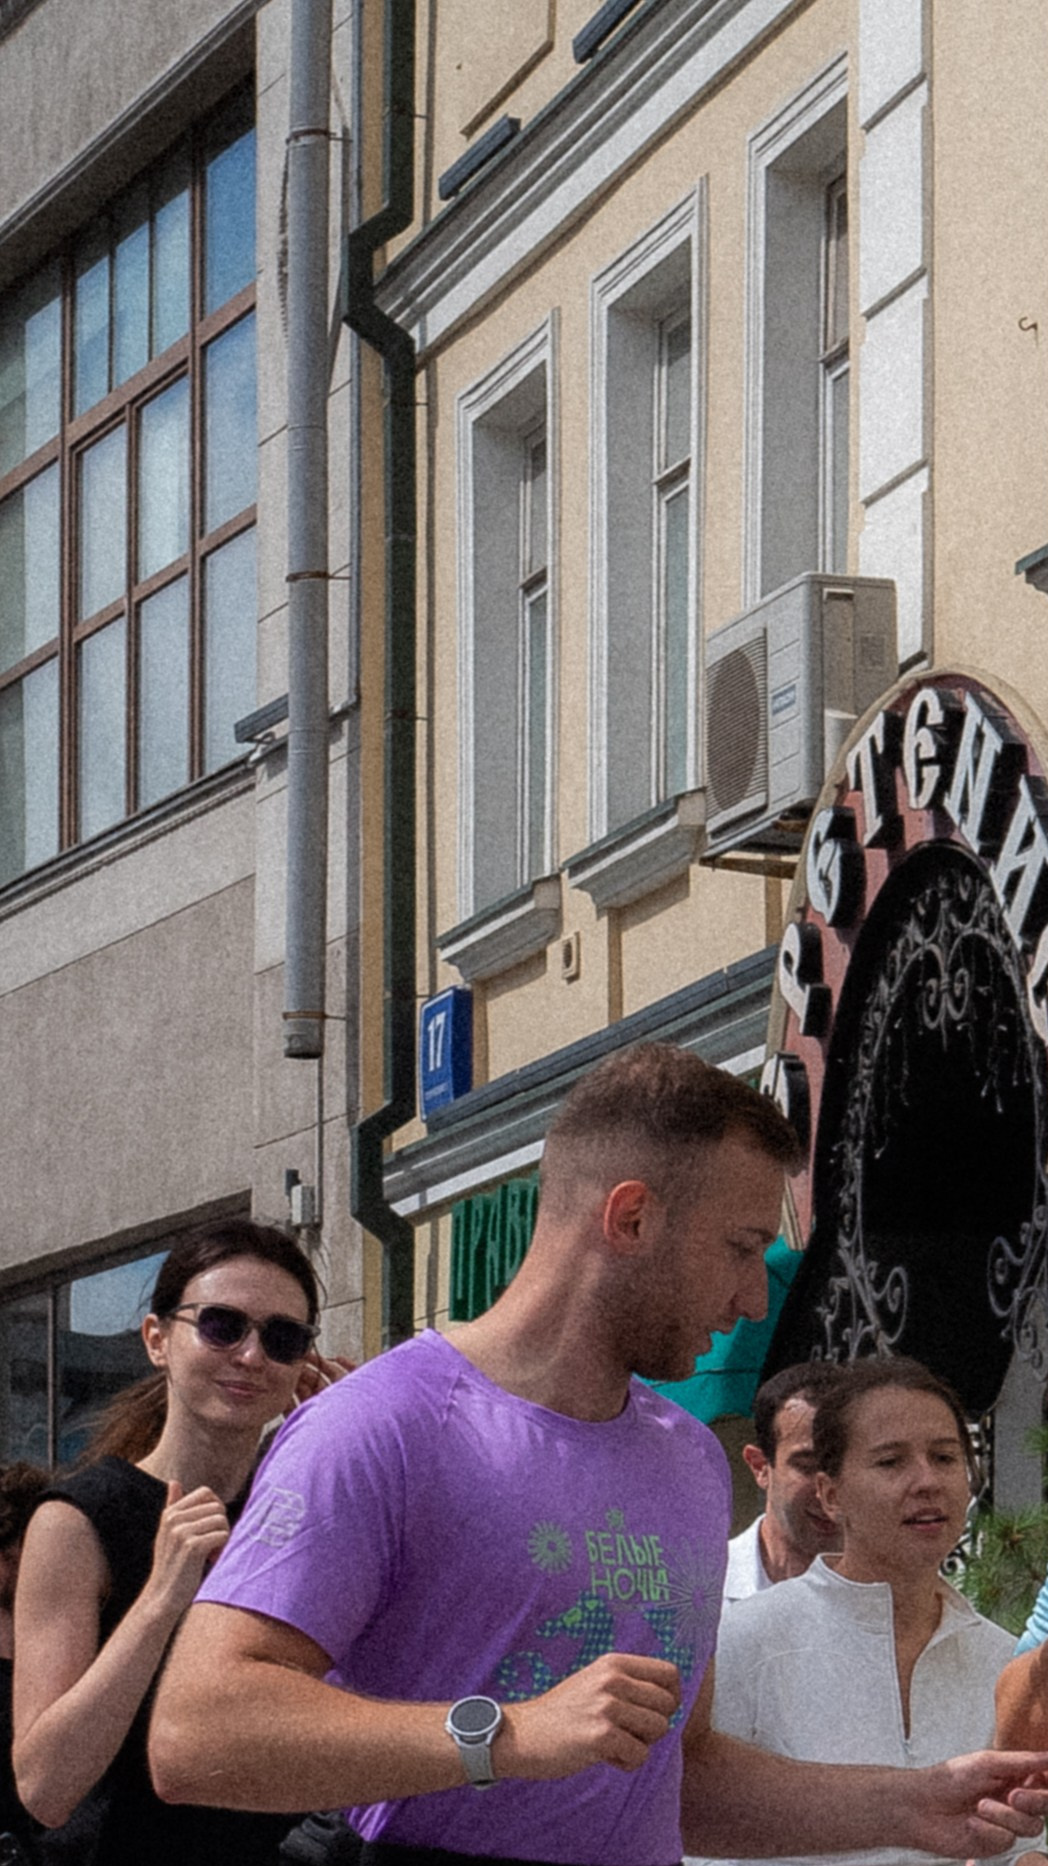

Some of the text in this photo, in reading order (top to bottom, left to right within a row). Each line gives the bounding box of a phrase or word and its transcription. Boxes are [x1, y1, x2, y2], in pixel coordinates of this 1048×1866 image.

[427, 1011, 446, 1072] 17
[584, 1530, 664, 1566] БЕЛЫЕ
[591, 1565, 670, 1601] НОЧИ
